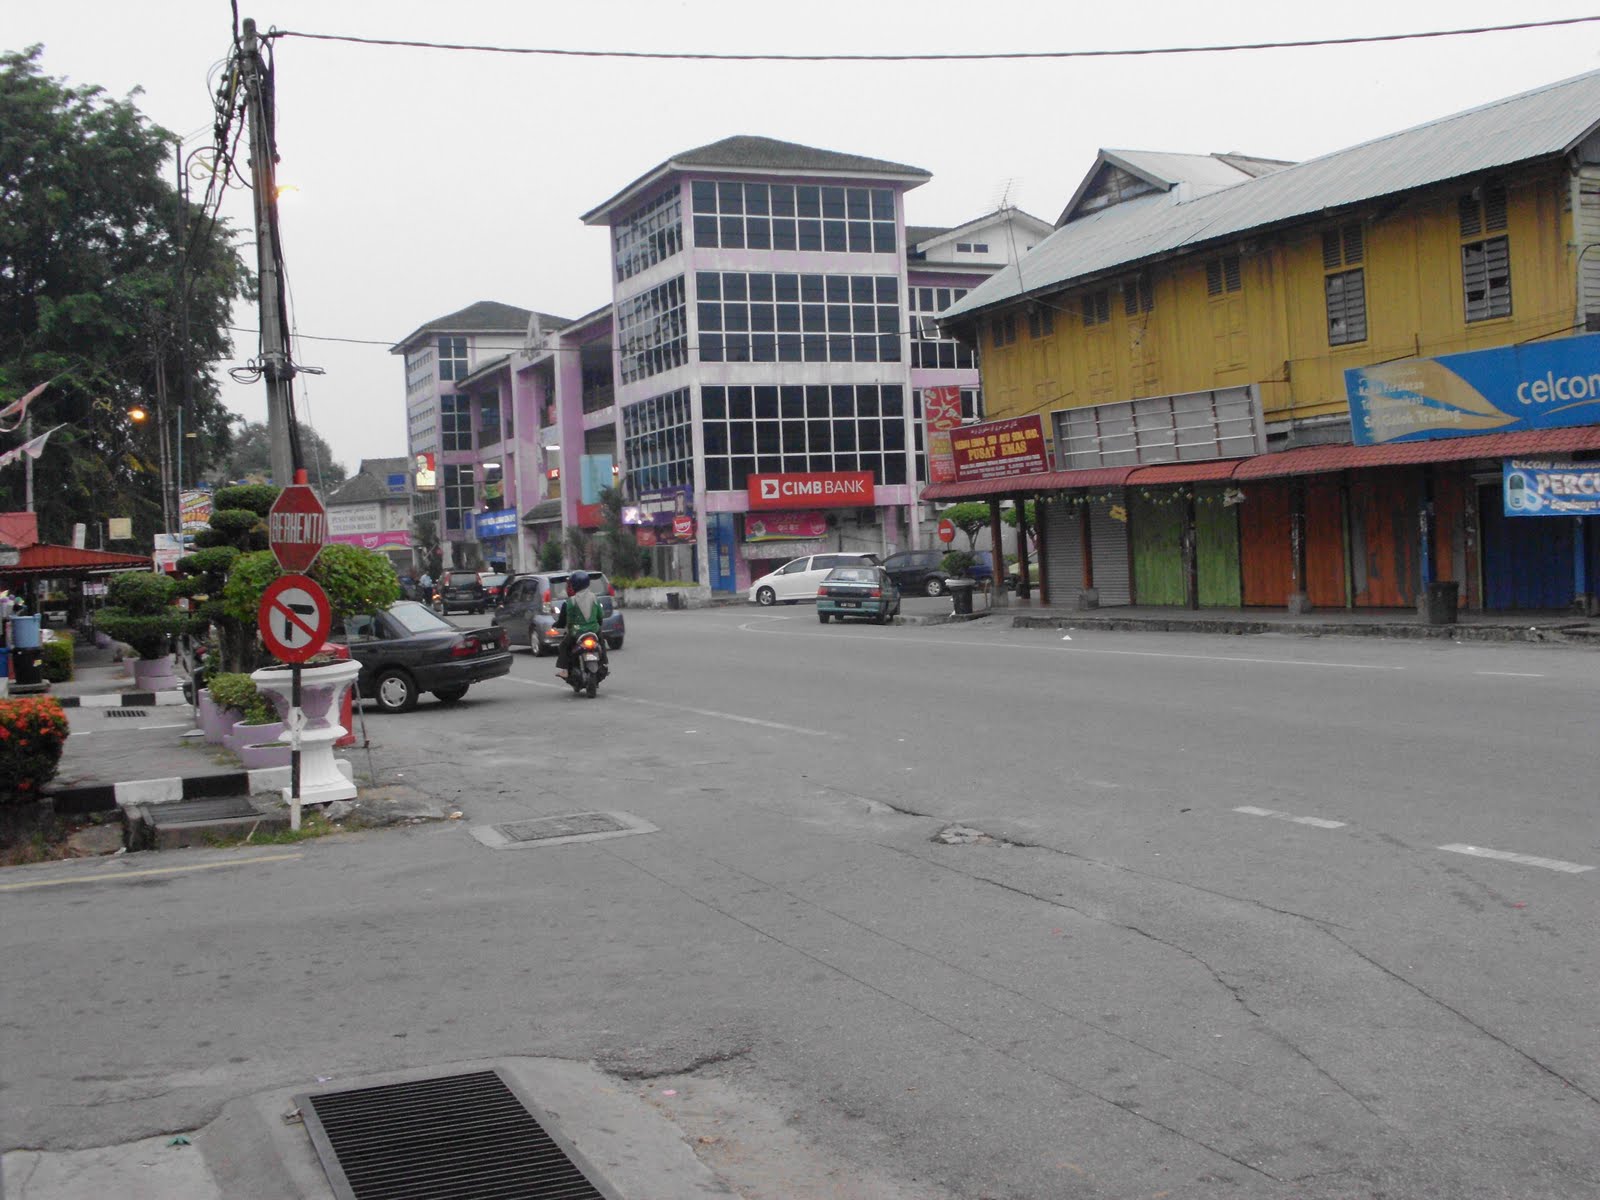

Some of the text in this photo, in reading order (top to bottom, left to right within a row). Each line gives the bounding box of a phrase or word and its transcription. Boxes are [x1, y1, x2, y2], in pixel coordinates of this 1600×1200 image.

[968, 446, 996, 461] PUSAT
[1001, 441, 1027, 457] EMAS
[782, 479, 865, 496] CIMB BANK
[271, 512, 323, 544] BERHENTI
